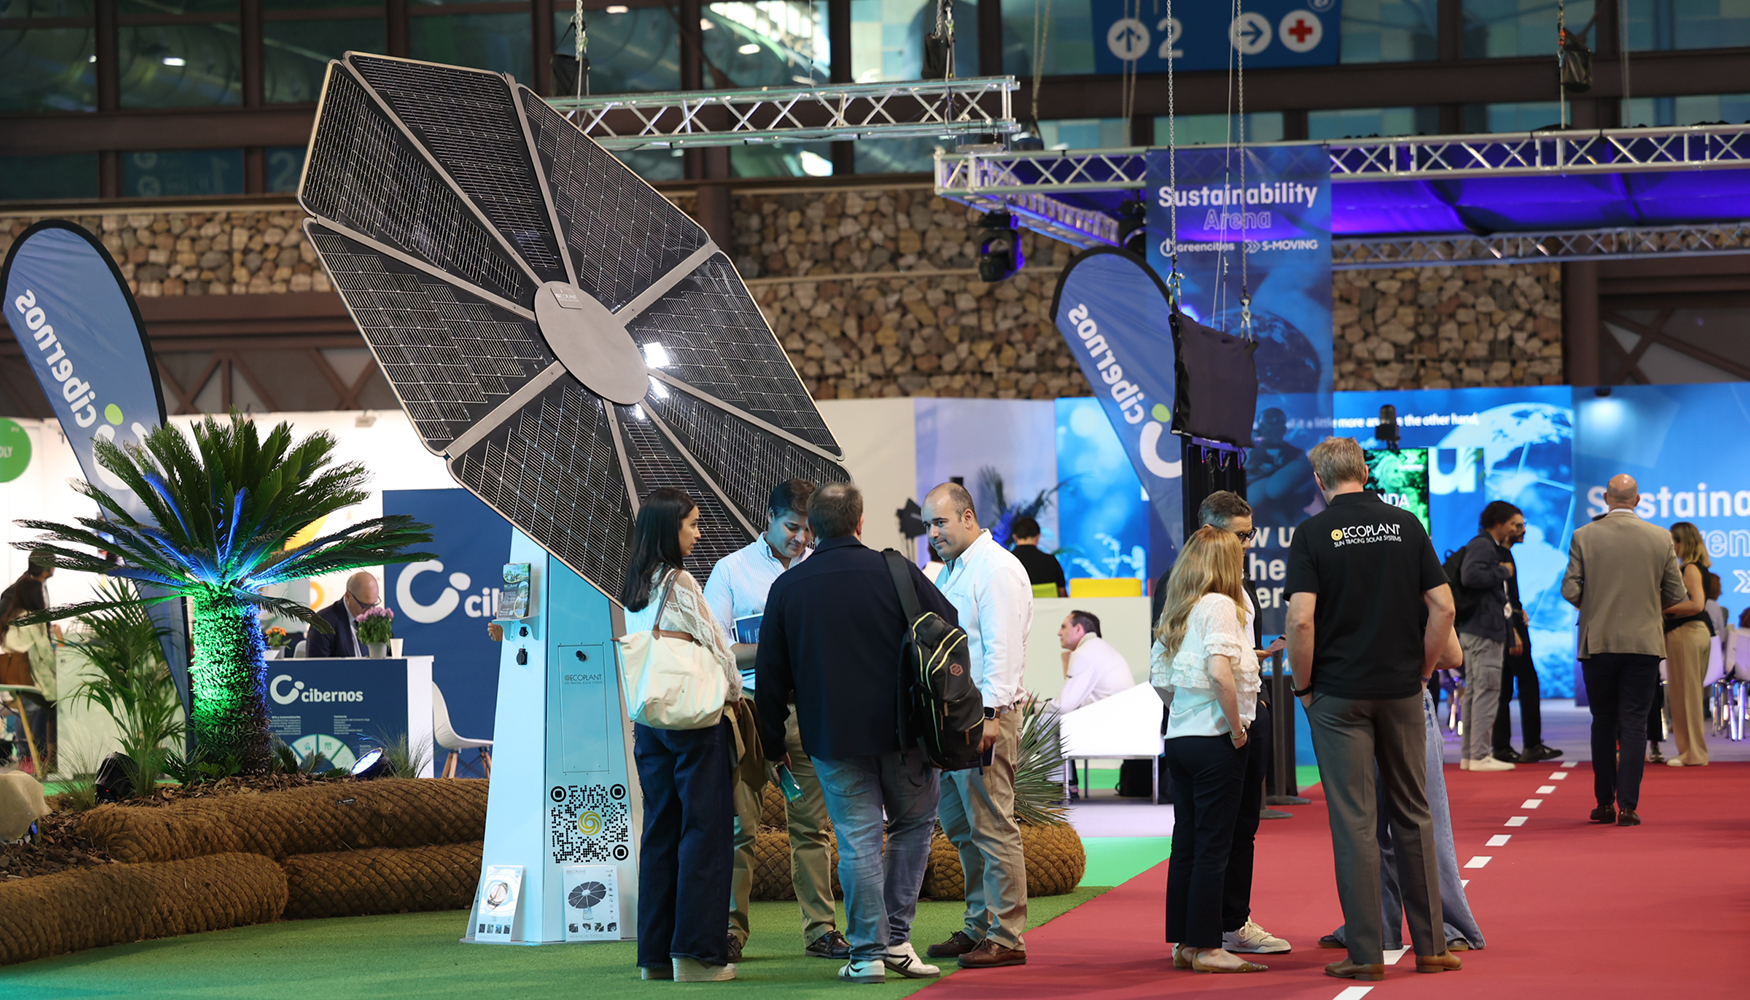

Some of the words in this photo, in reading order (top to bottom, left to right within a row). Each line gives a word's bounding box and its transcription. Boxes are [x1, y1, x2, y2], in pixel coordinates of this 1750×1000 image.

[1157, 17, 1184, 58] 2
[1158, 182, 1318, 208] Sustainability
[1203, 208, 1271, 230] Arena
[1261, 239, 1319, 251] S-MOVING
[1338, 417, 1365, 428] more
[1366, 417, 1381, 428] an
[1404, 413, 1422, 427] the
[1422, 412, 1450, 427] other
[1587, 482, 1750, 519] Sstaina
[1342, 523, 1400, 539] ECOPLANT
[1333, 540, 1345, 548] SUN
[570, 673, 602, 682] ECOPLANT
[301, 688, 364, 703] cibernos
